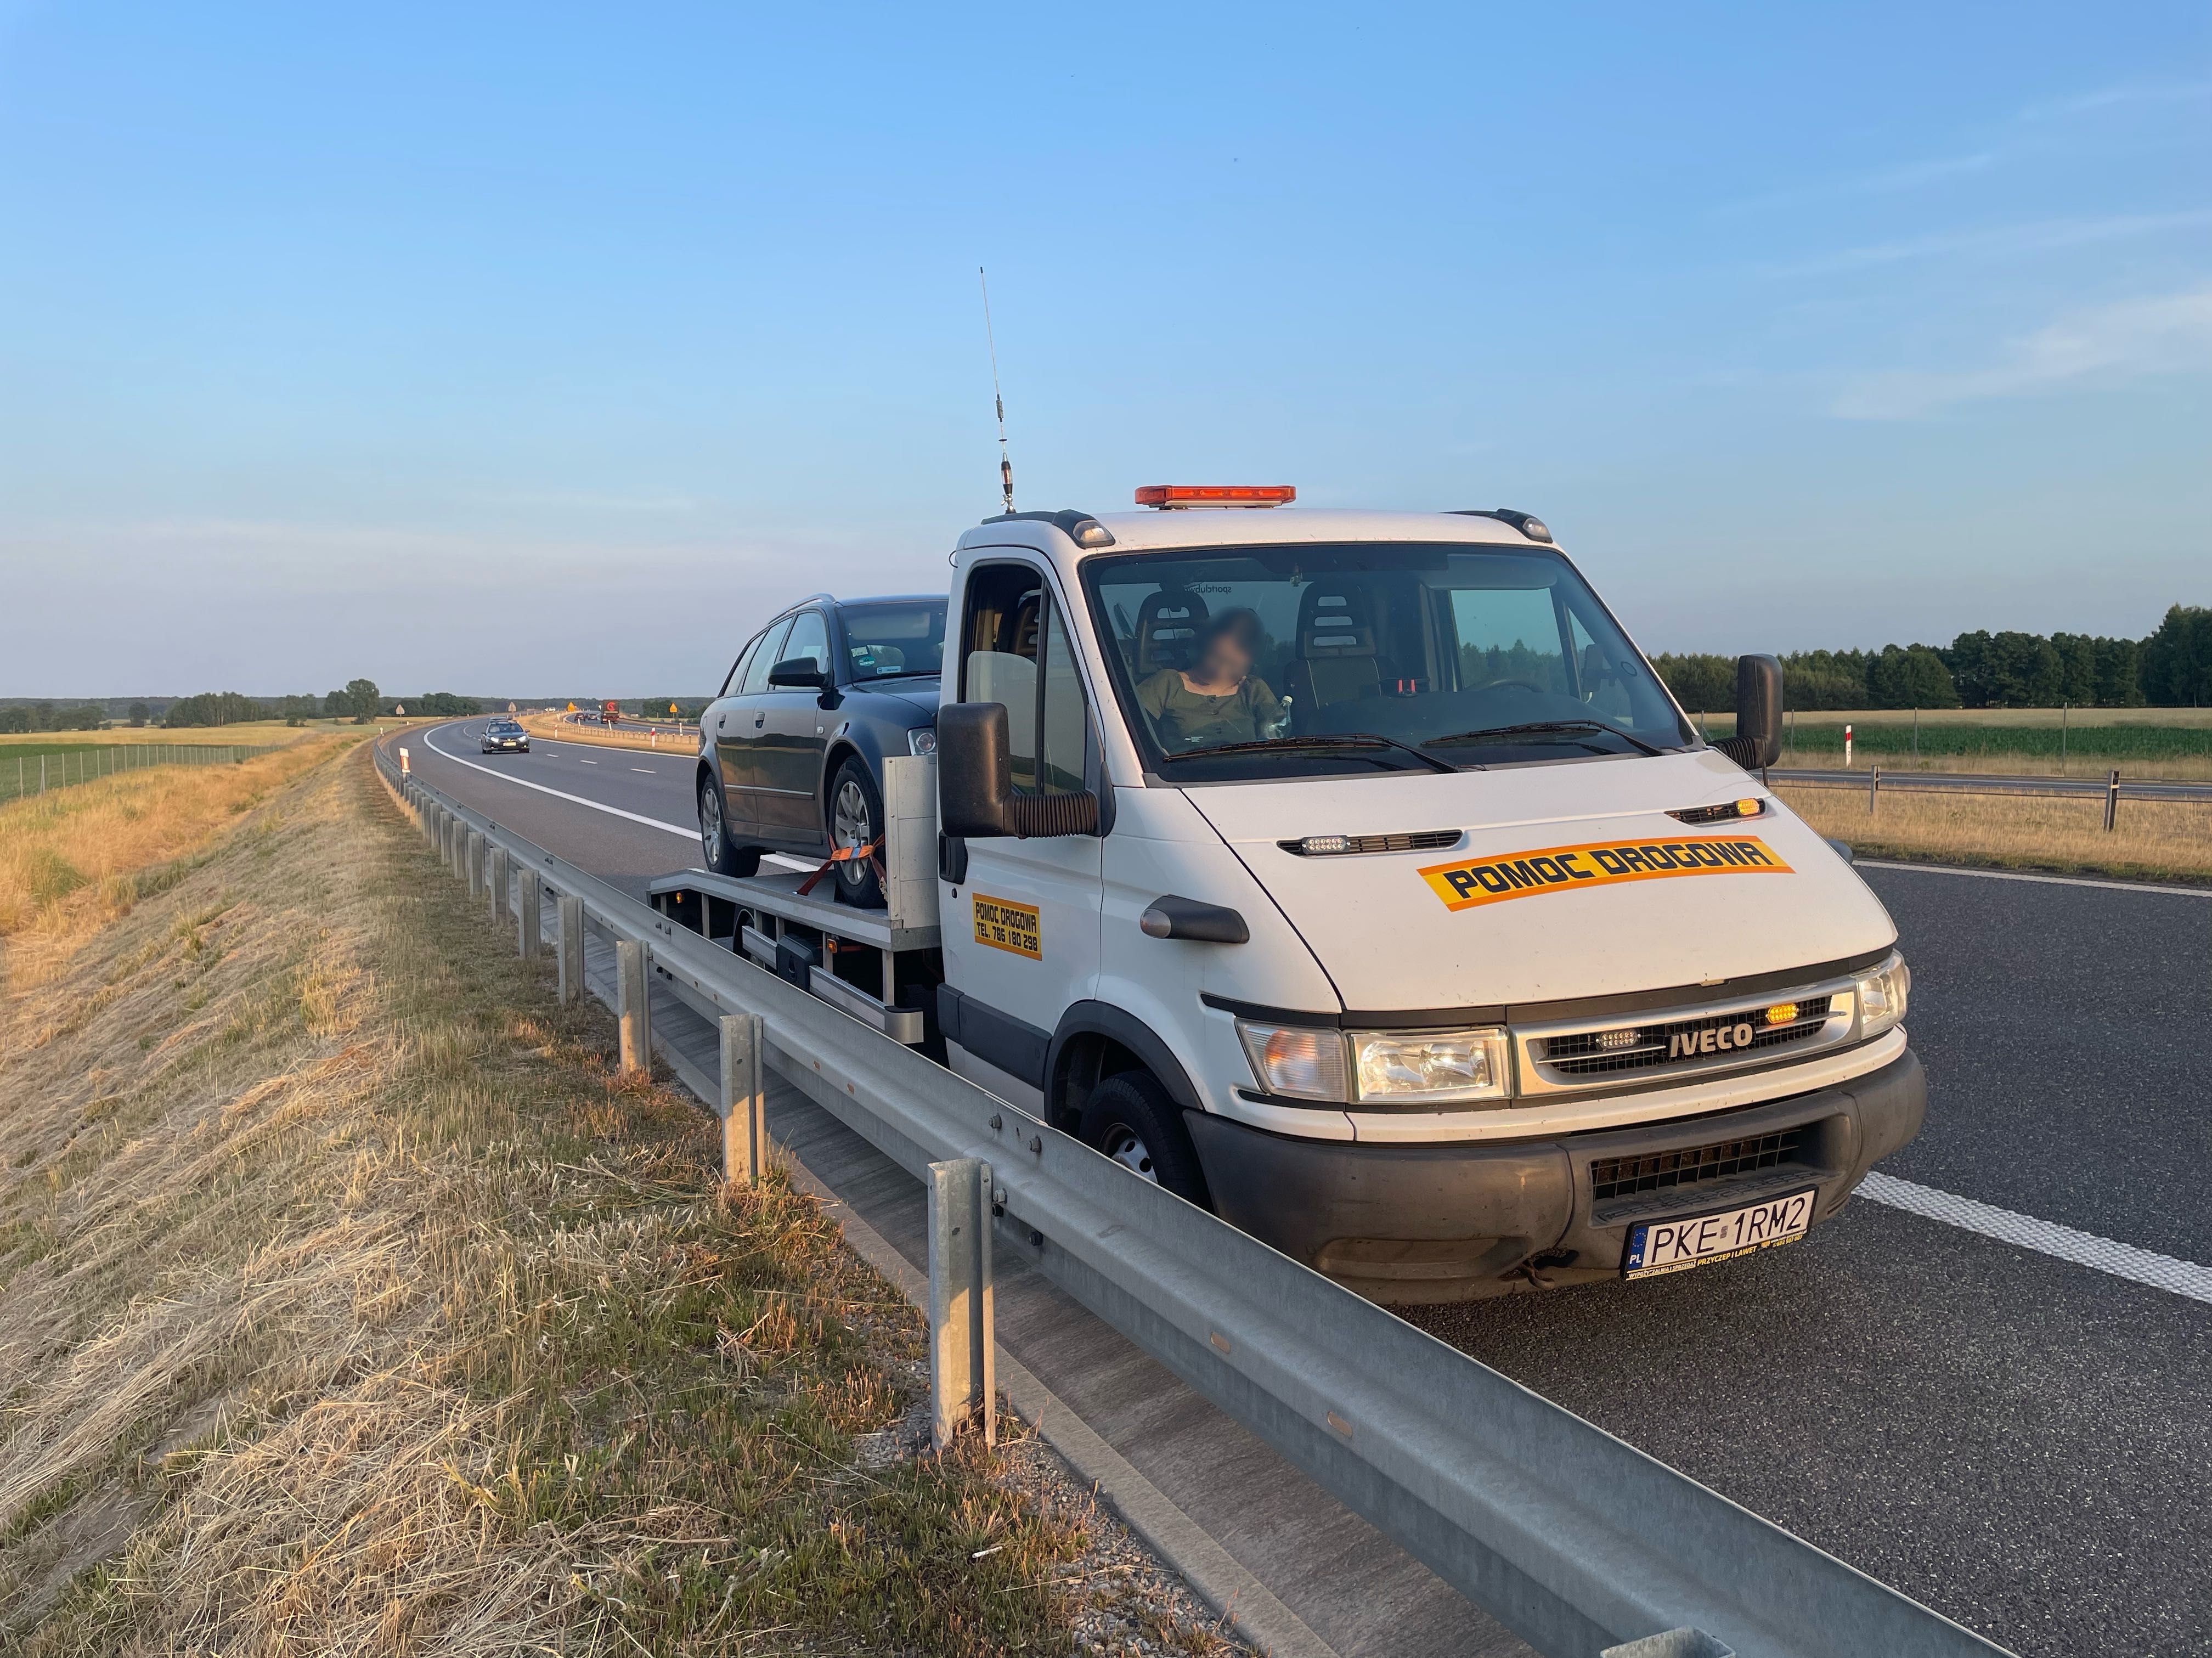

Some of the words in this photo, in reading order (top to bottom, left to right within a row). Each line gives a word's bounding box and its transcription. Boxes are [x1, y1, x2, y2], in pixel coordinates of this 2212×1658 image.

[1443, 854, 1595, 899] POMOC
[1588, 842, 1774, 875] DROGOWA
[975, 901, 999, 924] POMOC
[1000, 907, 1037, 934] DROGOWA
[977, 922, 990, 938] TEL.
[992, 926, 1006, 942] 786
[1008, 930, 1021, 947] 180
[1023, 934, 1037, 951] 298
[1669, 1023, 1753, 1058] IVECO
[1651, 1218, 1720, 1264] PKE
[1735, 1197, 1805, 1245] 1RM2
[1629, 1254, 1641, 1265] PL
[1697, 1253, 1731, 1266] PRZYCZEP
[1735, 1245, 1757, 1257] LAWET
